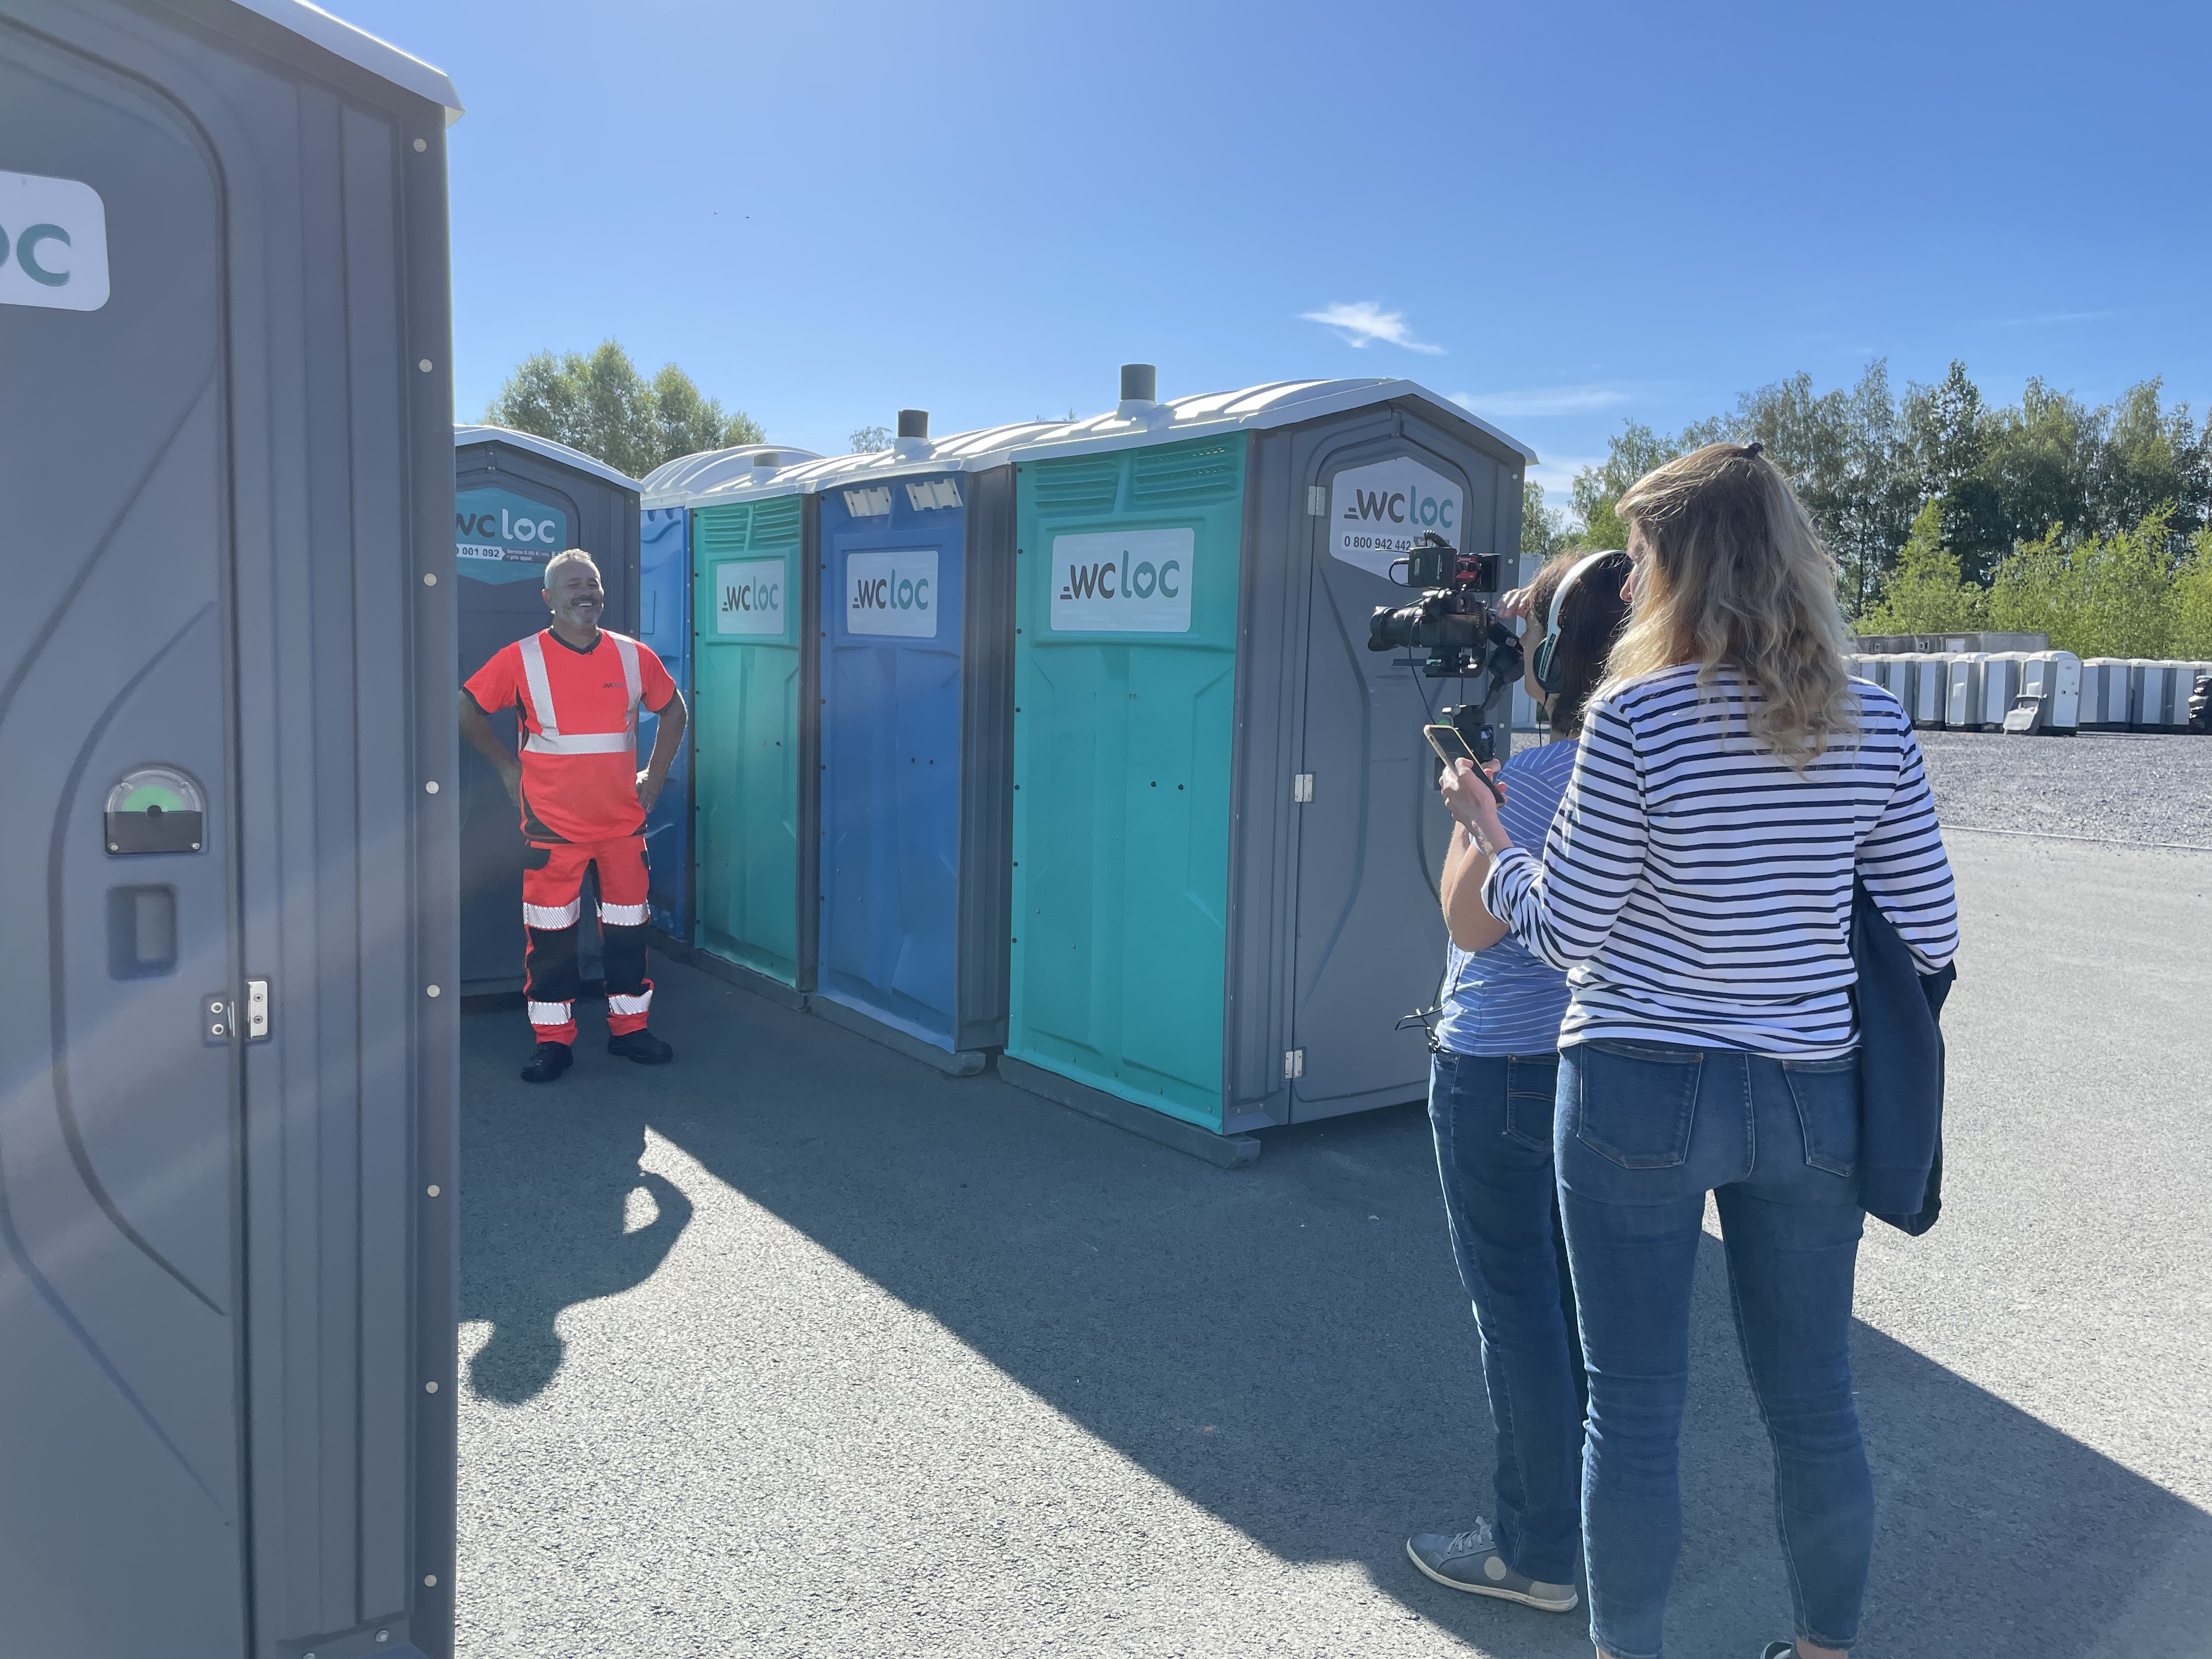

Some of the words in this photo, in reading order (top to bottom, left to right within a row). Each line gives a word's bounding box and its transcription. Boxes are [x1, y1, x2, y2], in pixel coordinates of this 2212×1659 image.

[0, 222, 71, 287] c
[1344, 535, 1351, 547] 0
[1353, 537, 1372, 548] 800
[1375, 538, 1392, 550] 942
[1395, 540, 1411, 551] 442
[462, 547, 478, 556] 001
[483, 549, 499, 558] 092
